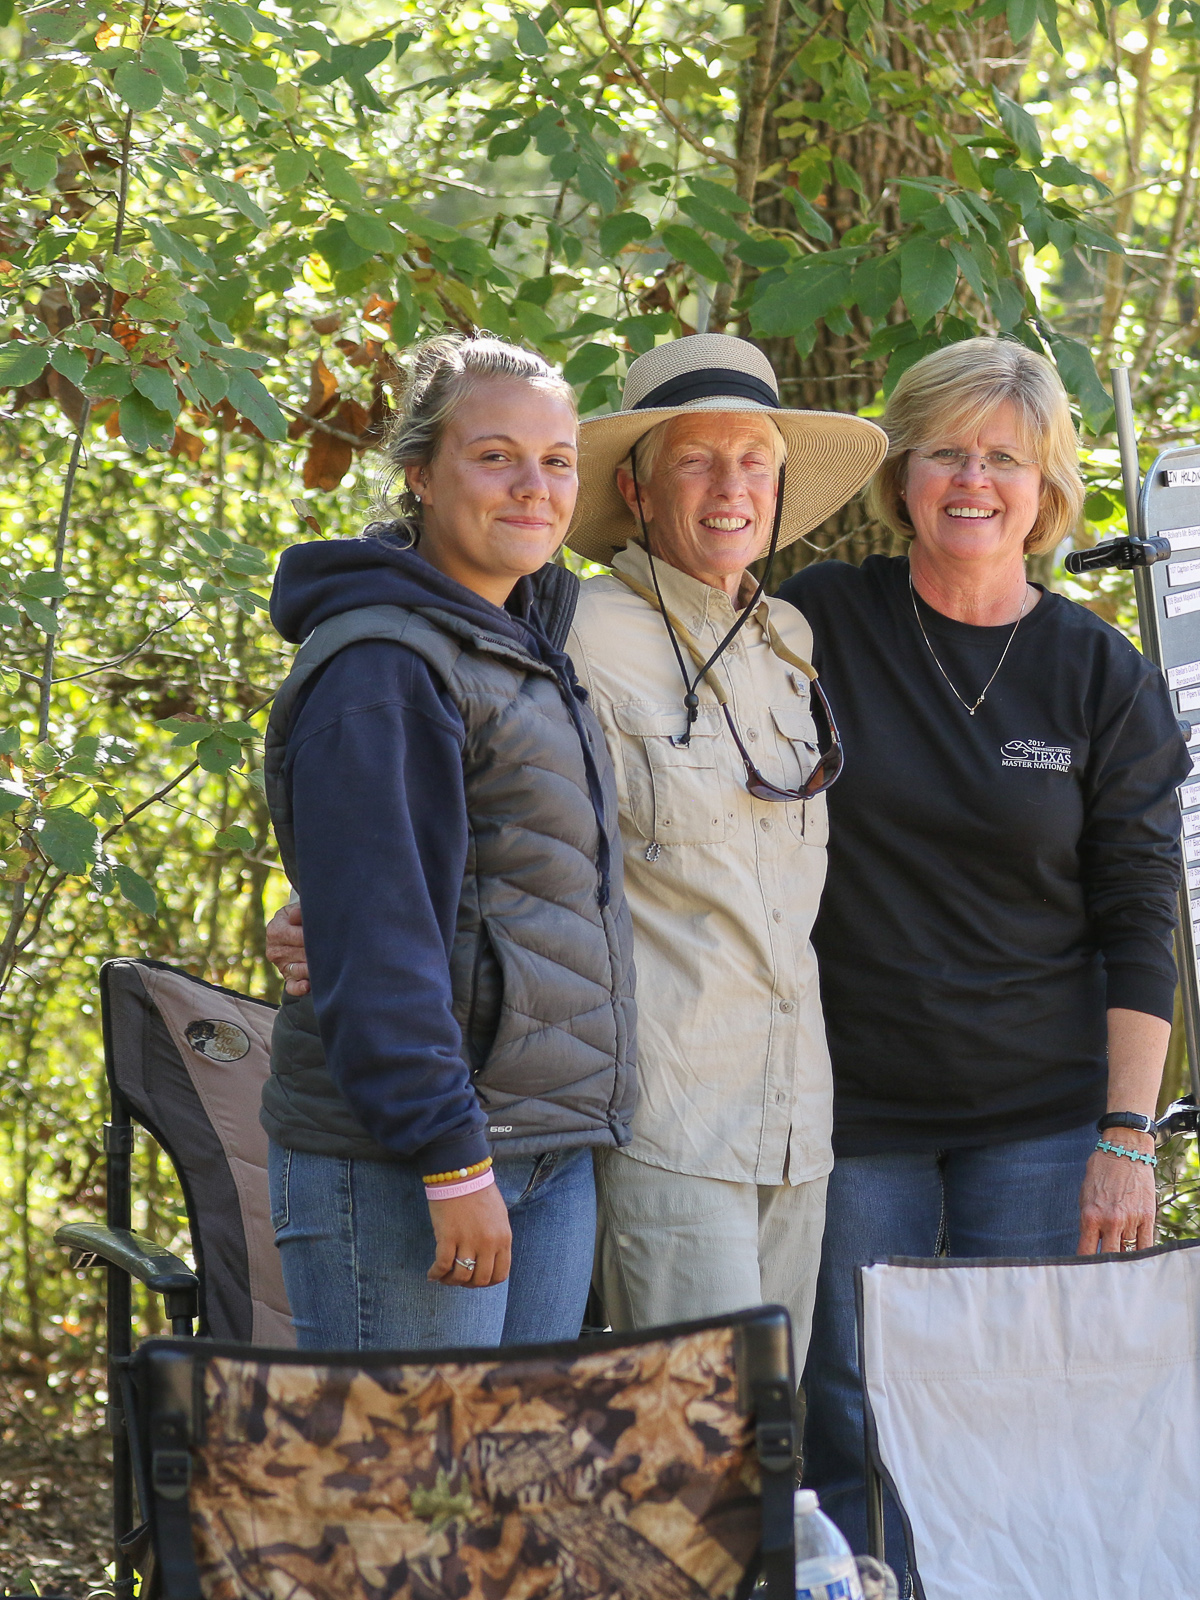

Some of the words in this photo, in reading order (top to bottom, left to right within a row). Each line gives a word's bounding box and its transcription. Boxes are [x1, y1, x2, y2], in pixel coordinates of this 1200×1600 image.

[1168, 471, 1177, 482] IN
[1028, 739, 1045, 747] 2017
[1033, 751, 1072, 765] TEXAS
[1002, 760, 1032, 768] MASTER
[1033, 762, 1069, 773] NATIONAL
[216, 1022, 242, 1037] Bass
[214, 1043, 242, 1057] Shops
